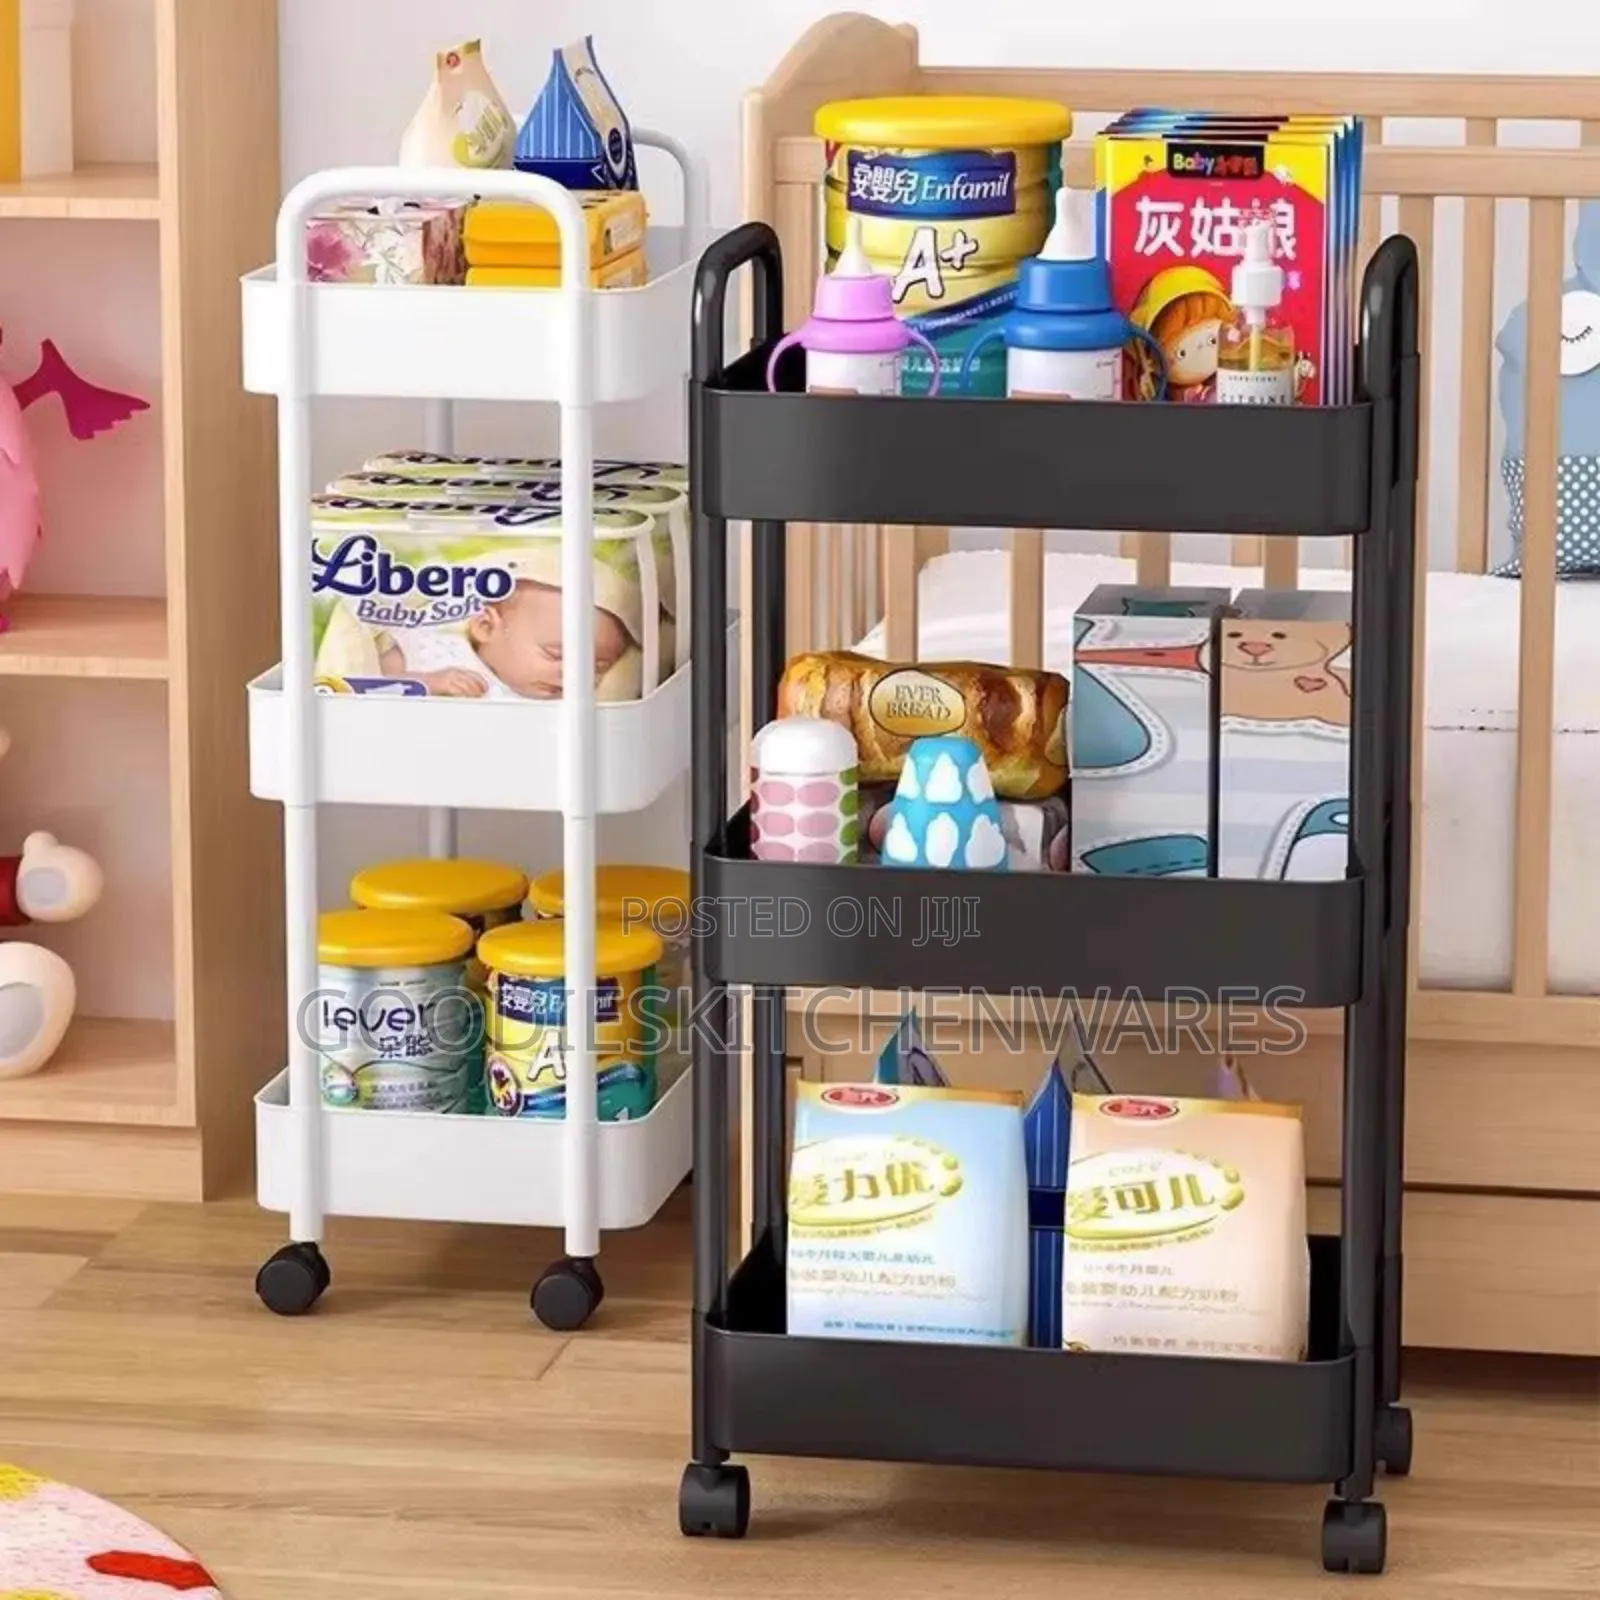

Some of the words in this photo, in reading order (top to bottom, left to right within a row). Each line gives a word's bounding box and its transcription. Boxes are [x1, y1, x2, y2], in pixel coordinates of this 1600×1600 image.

[1173, 151, 1215, 176] Baby
[921, 171, 1011, 201] Enfamil
[892, 226, 979, 304] A+
[312, 535, 512, 598] Libero
[357, 600, 426, 628] Baby
[431, 594, 482, 621] Soft
[895, 683, 943, 705] EVER
[887, 701, 951, 720] BREAD
